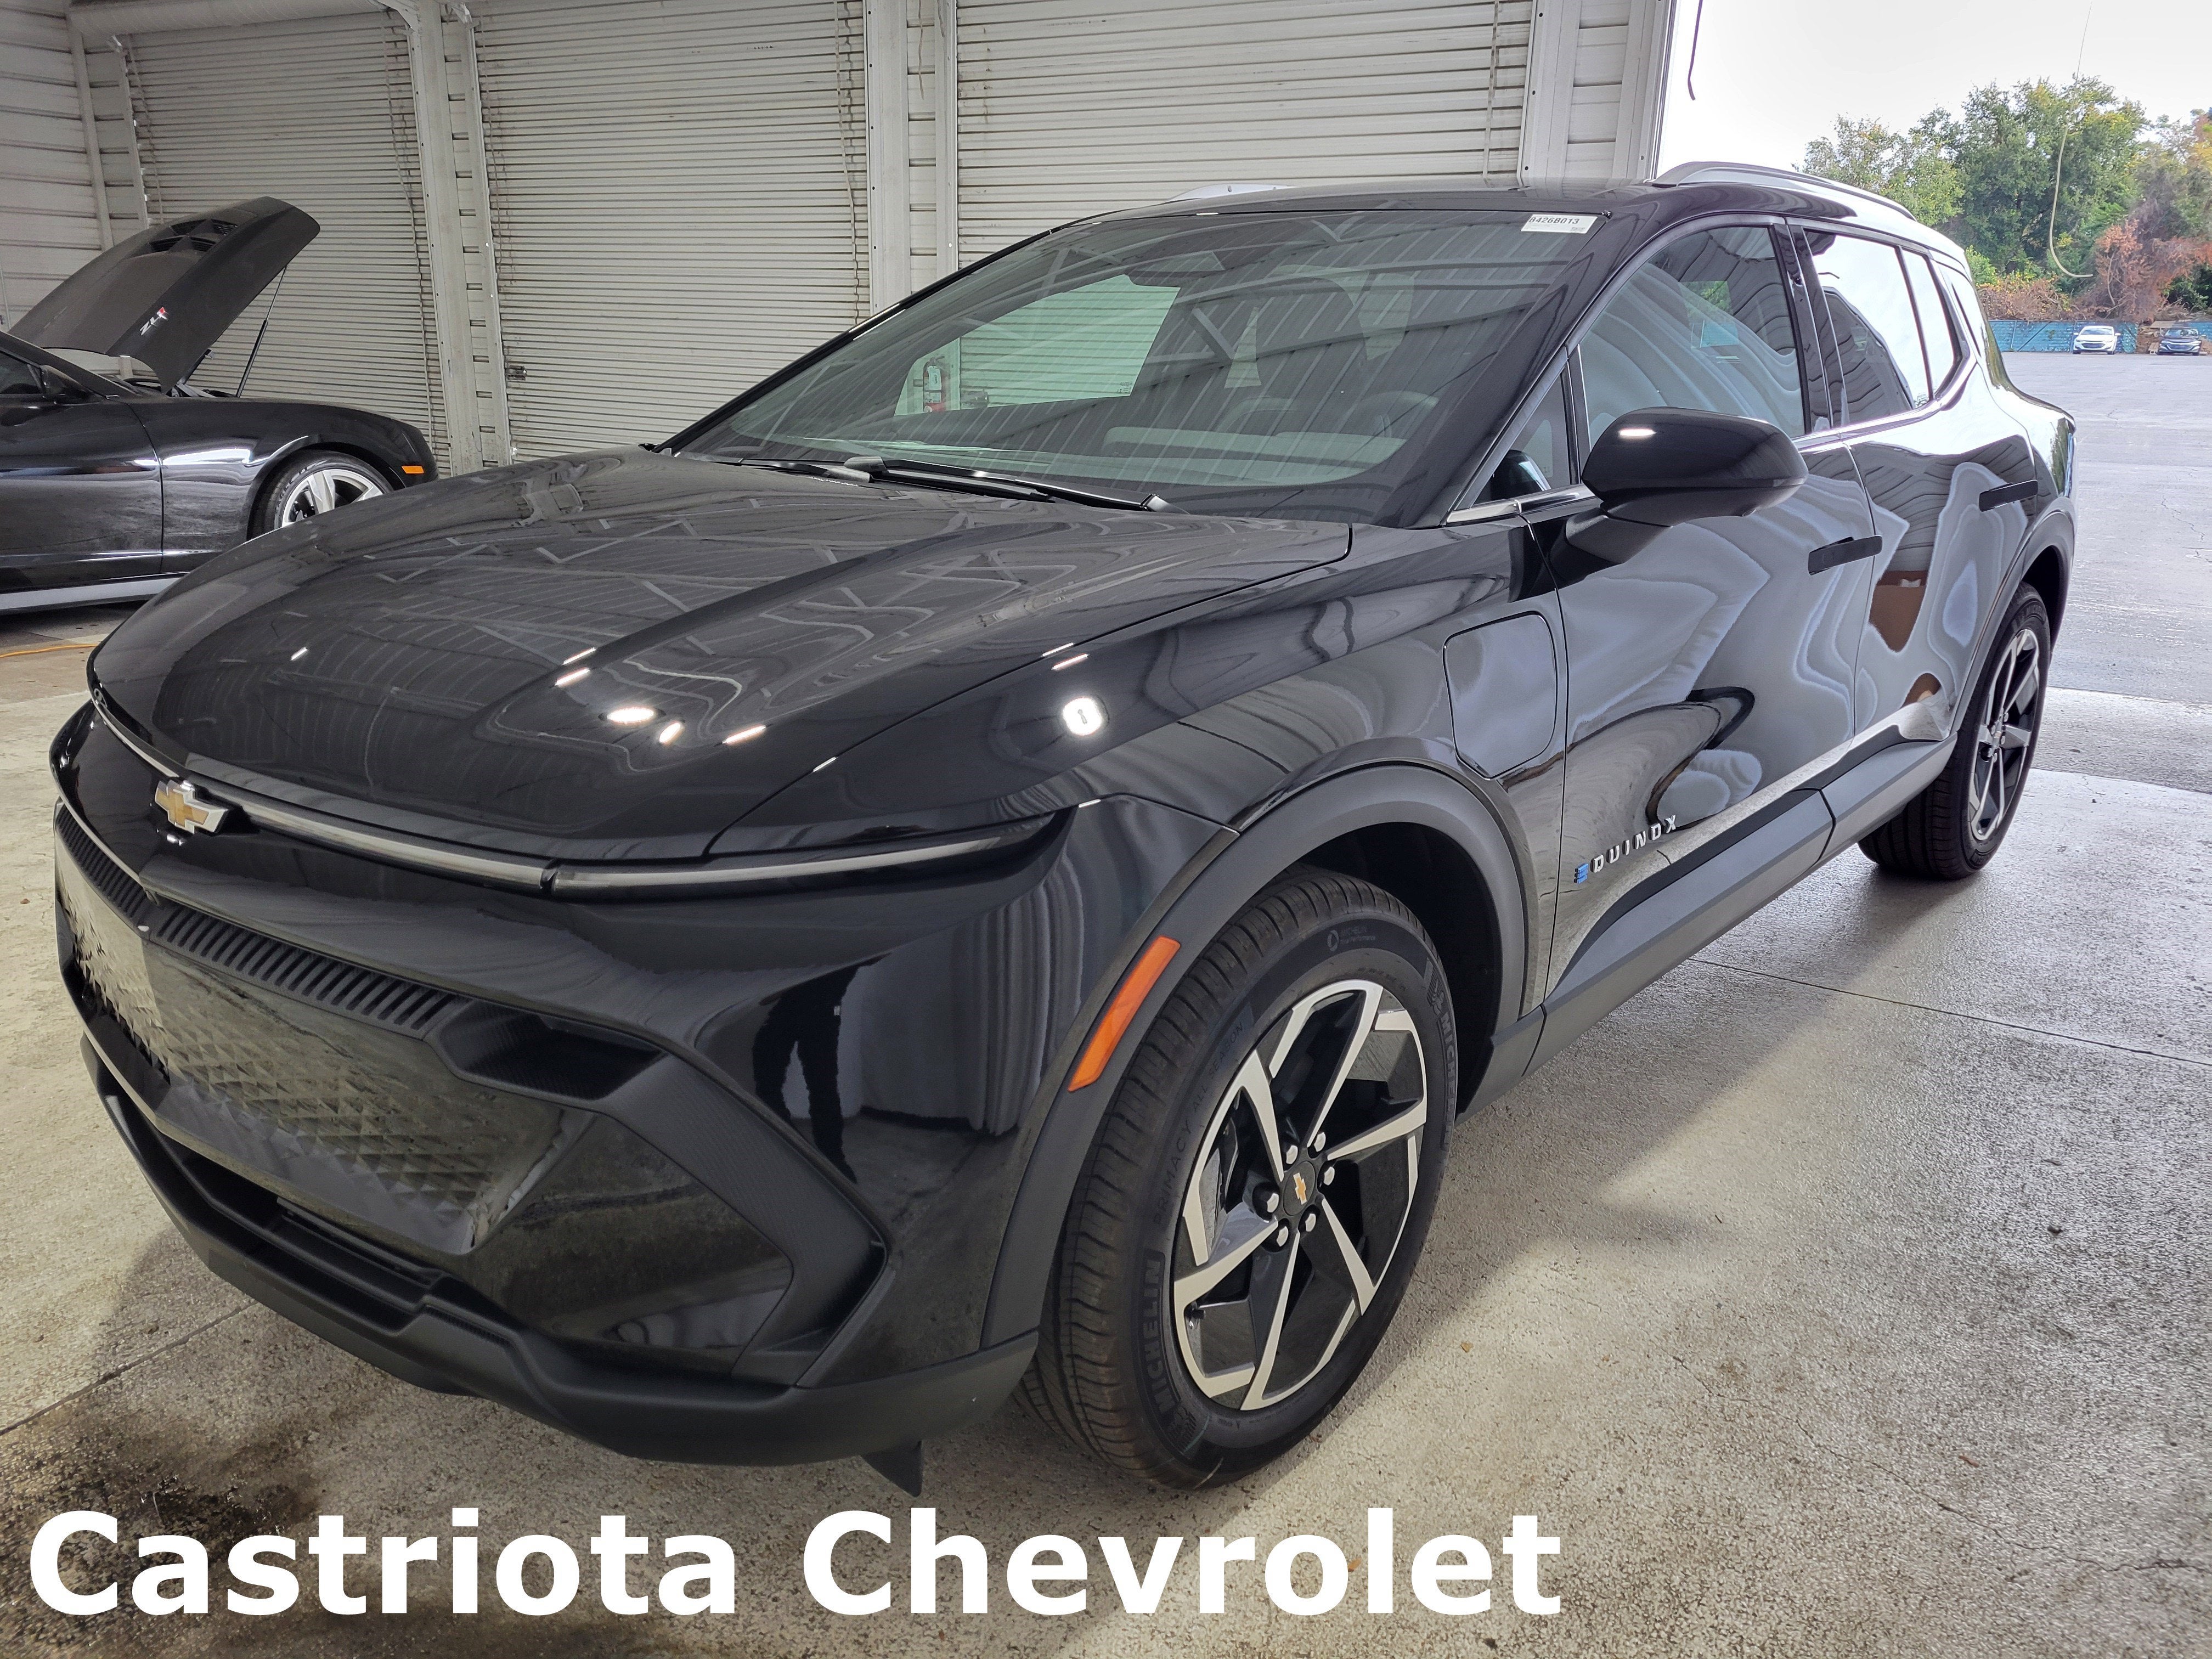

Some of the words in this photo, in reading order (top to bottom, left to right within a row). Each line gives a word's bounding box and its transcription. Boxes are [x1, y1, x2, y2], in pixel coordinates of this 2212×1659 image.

[1574, 815, 1677, 884] EQUINOX
[1193, 1085, 1207, 1113] ALL
[1210, 1020, 1244, 1081] SEASON
[1143, 1258, 1175, 1414] MICHELIN
